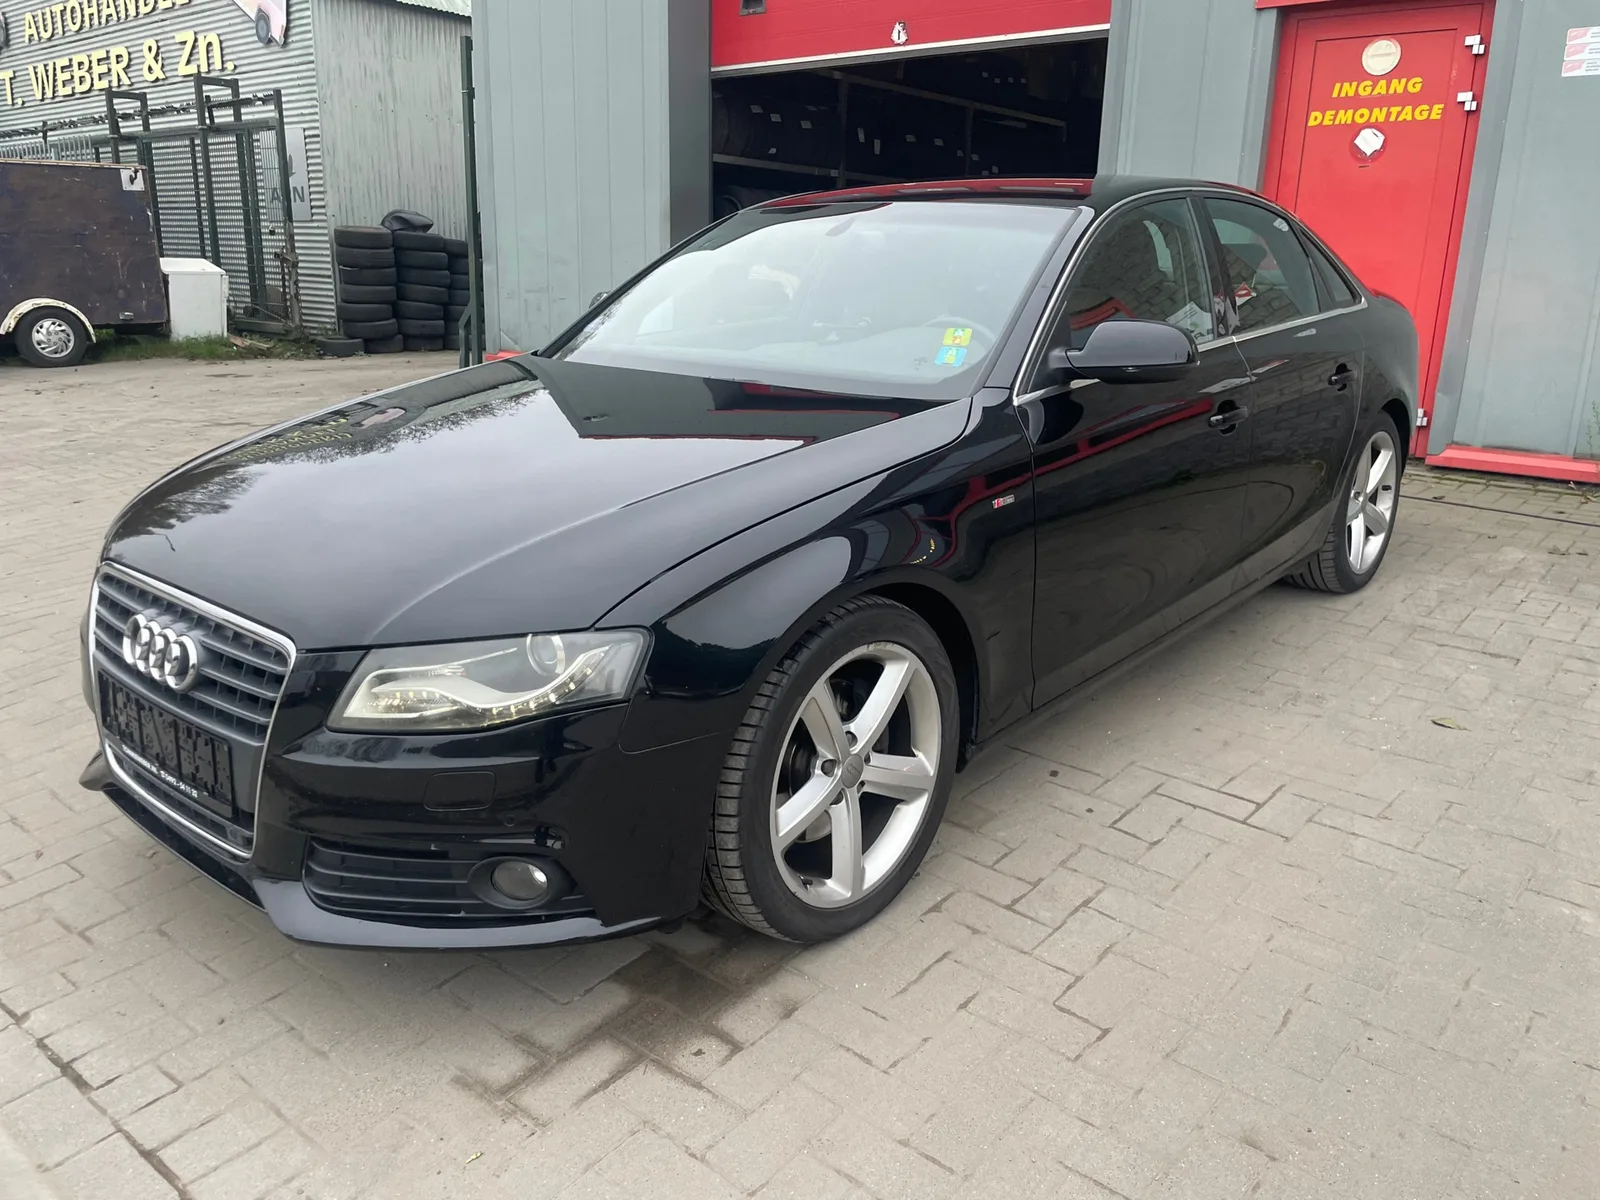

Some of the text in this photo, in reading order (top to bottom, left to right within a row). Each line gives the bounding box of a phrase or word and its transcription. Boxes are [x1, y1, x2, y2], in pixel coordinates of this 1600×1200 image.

[0, 30, 237, 105] T. WEBER & Zn.
[1332, 77, 1423, 98] INGANG
[1308, 104, 1444, 126] DEMONTAGE
